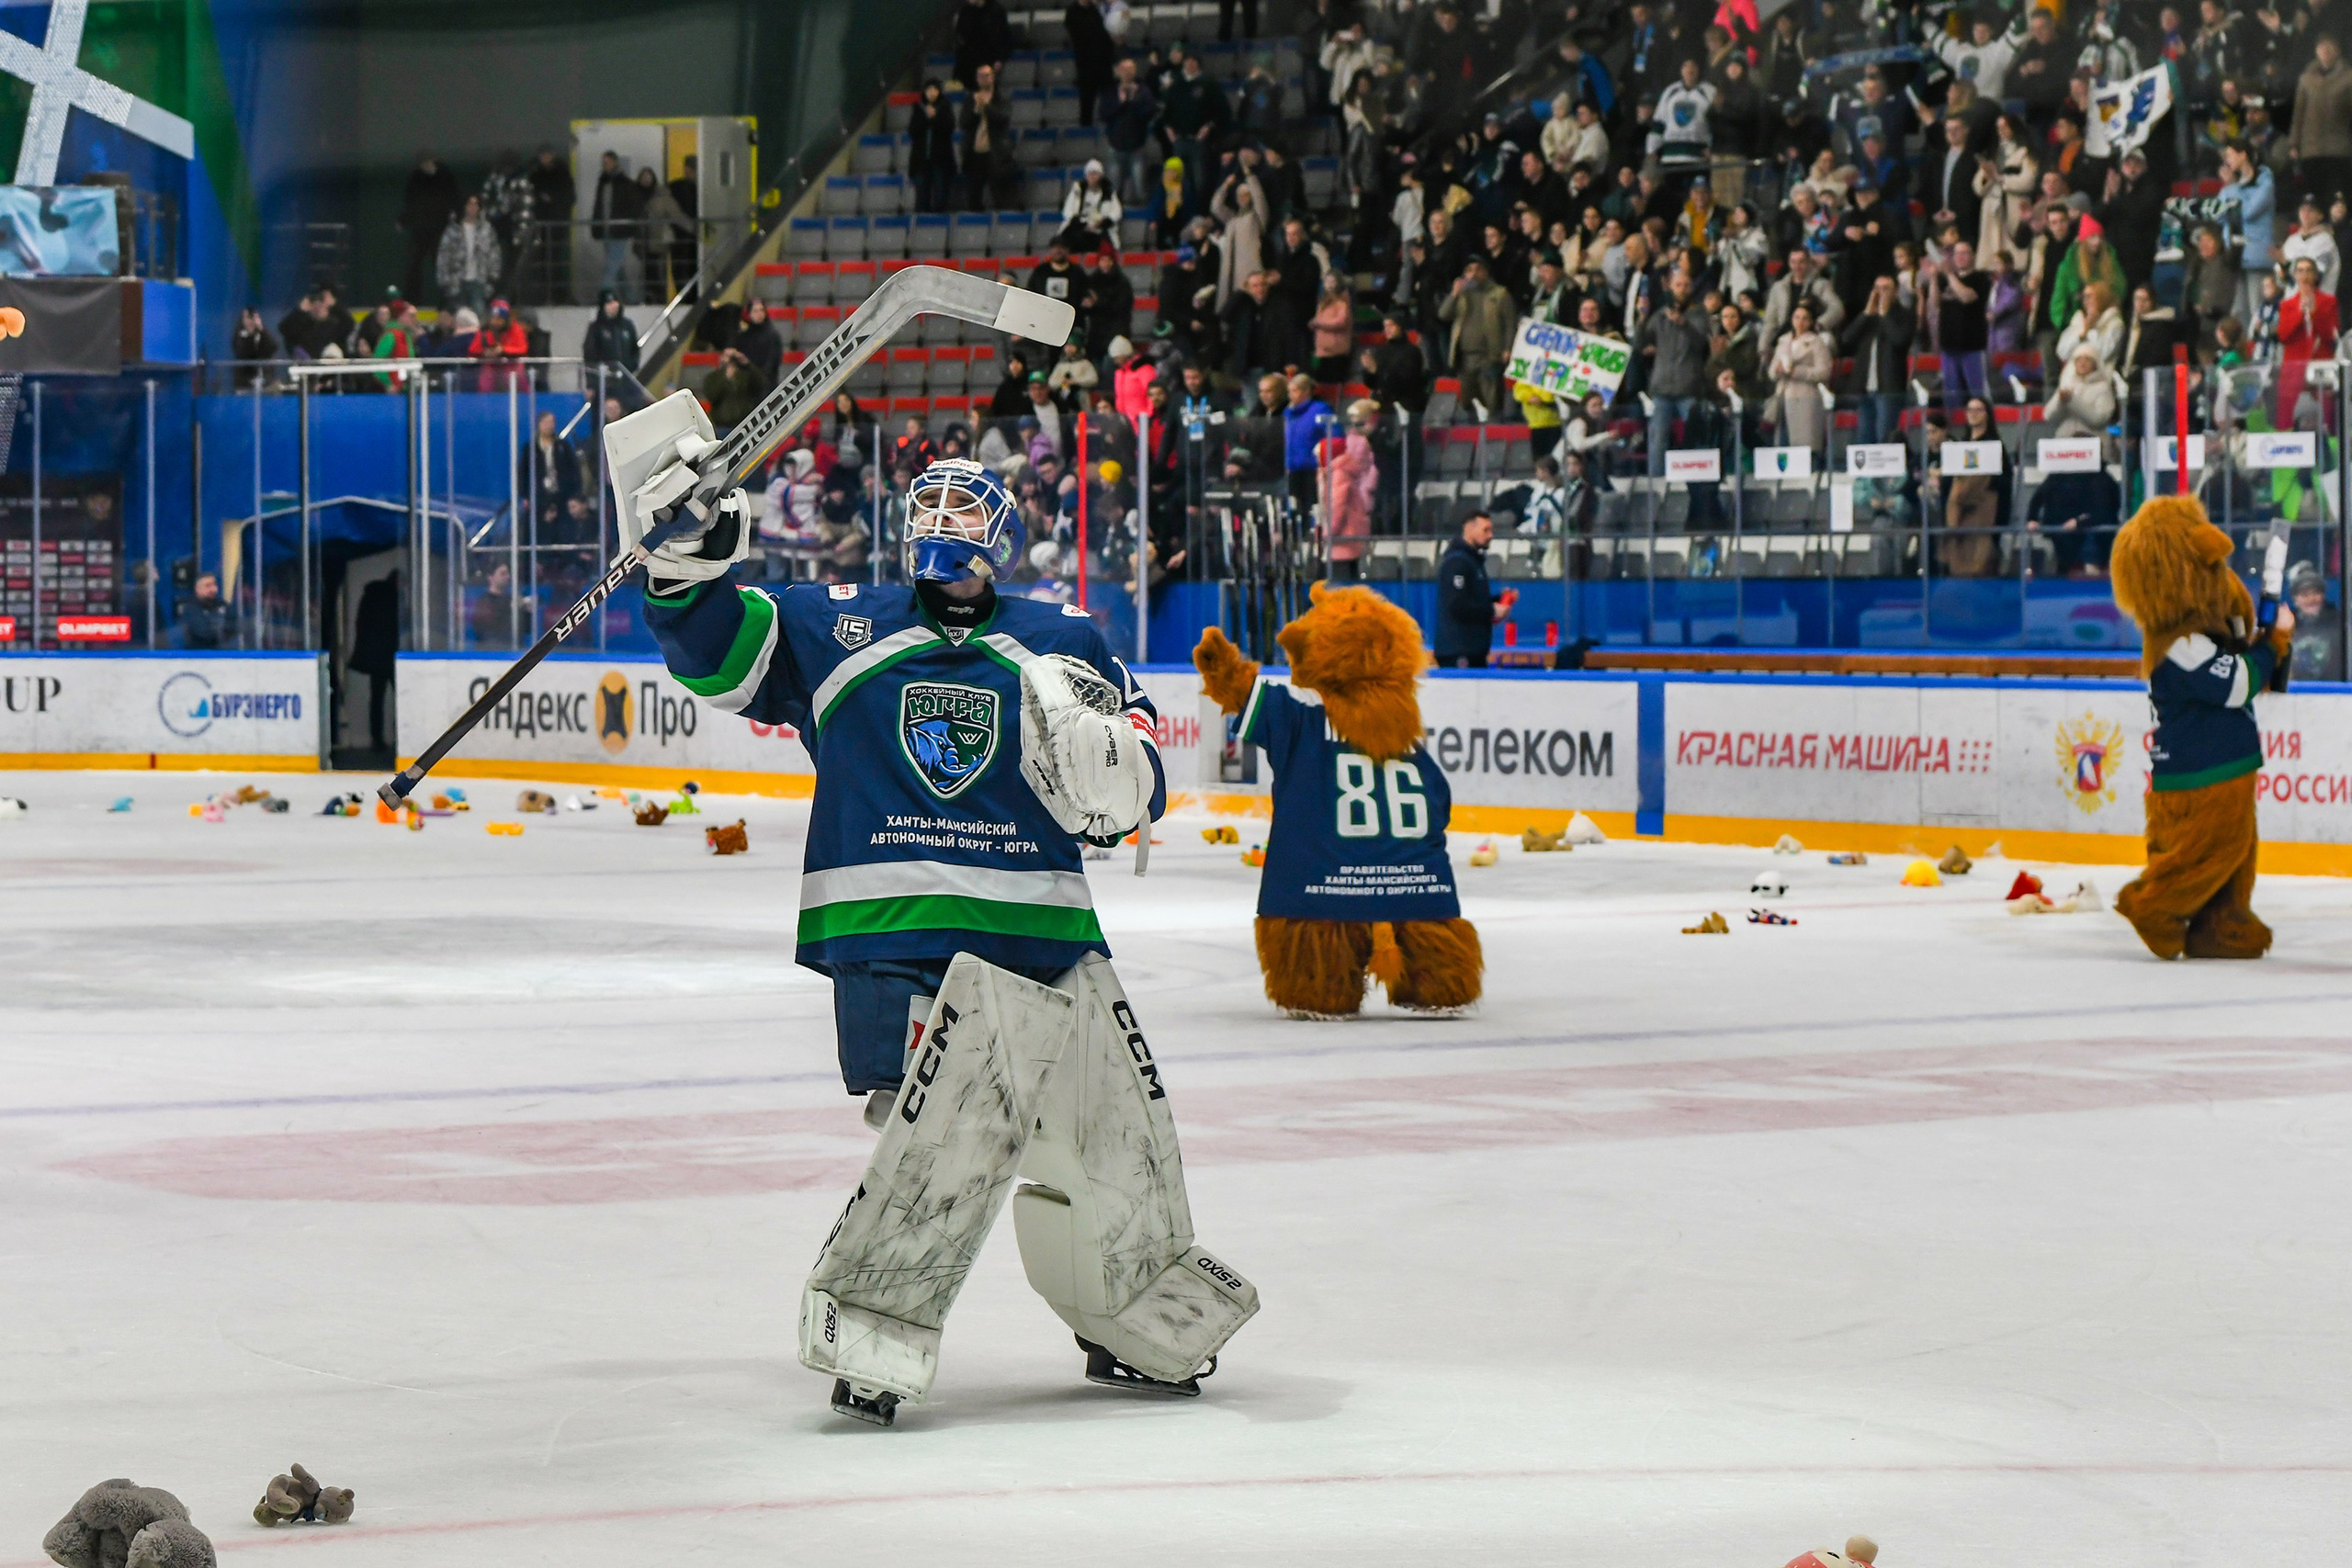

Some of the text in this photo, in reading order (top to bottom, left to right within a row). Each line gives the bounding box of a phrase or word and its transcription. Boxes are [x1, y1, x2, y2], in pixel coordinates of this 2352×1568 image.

[58, 622, 128, 635] OLIMPBET
[211, 694, 301, 719] БУРЭНЕРГО
[908, 694, 992, 726] ЮГРА
[910, 688, 991, 702] ХОККЕЙНЫЙ КЛУБ
[469, 678, 696, 746] Яндекс Про
[1104, 725, 1118, 766] CYBER
[1678, 731, 1951, 773] КРАСНАЯ МАШИНА
[1336, 752, 1429, 838] 86
[2256, 773, 2352, 803] РОССИ
[887, 815, 1017, 836] ХАНТЫ-МАНСИЙСКИЙ
[870, 832, 956, 848] АВТОНОМНЫЙ
[957, 838, 993, 852] ОКРУГ
[1003, 841, 1039, 853] ЮГРА
[901, 1001, 960, 1124] CCM
[1112, 1000, 1166, 1100] CCM
